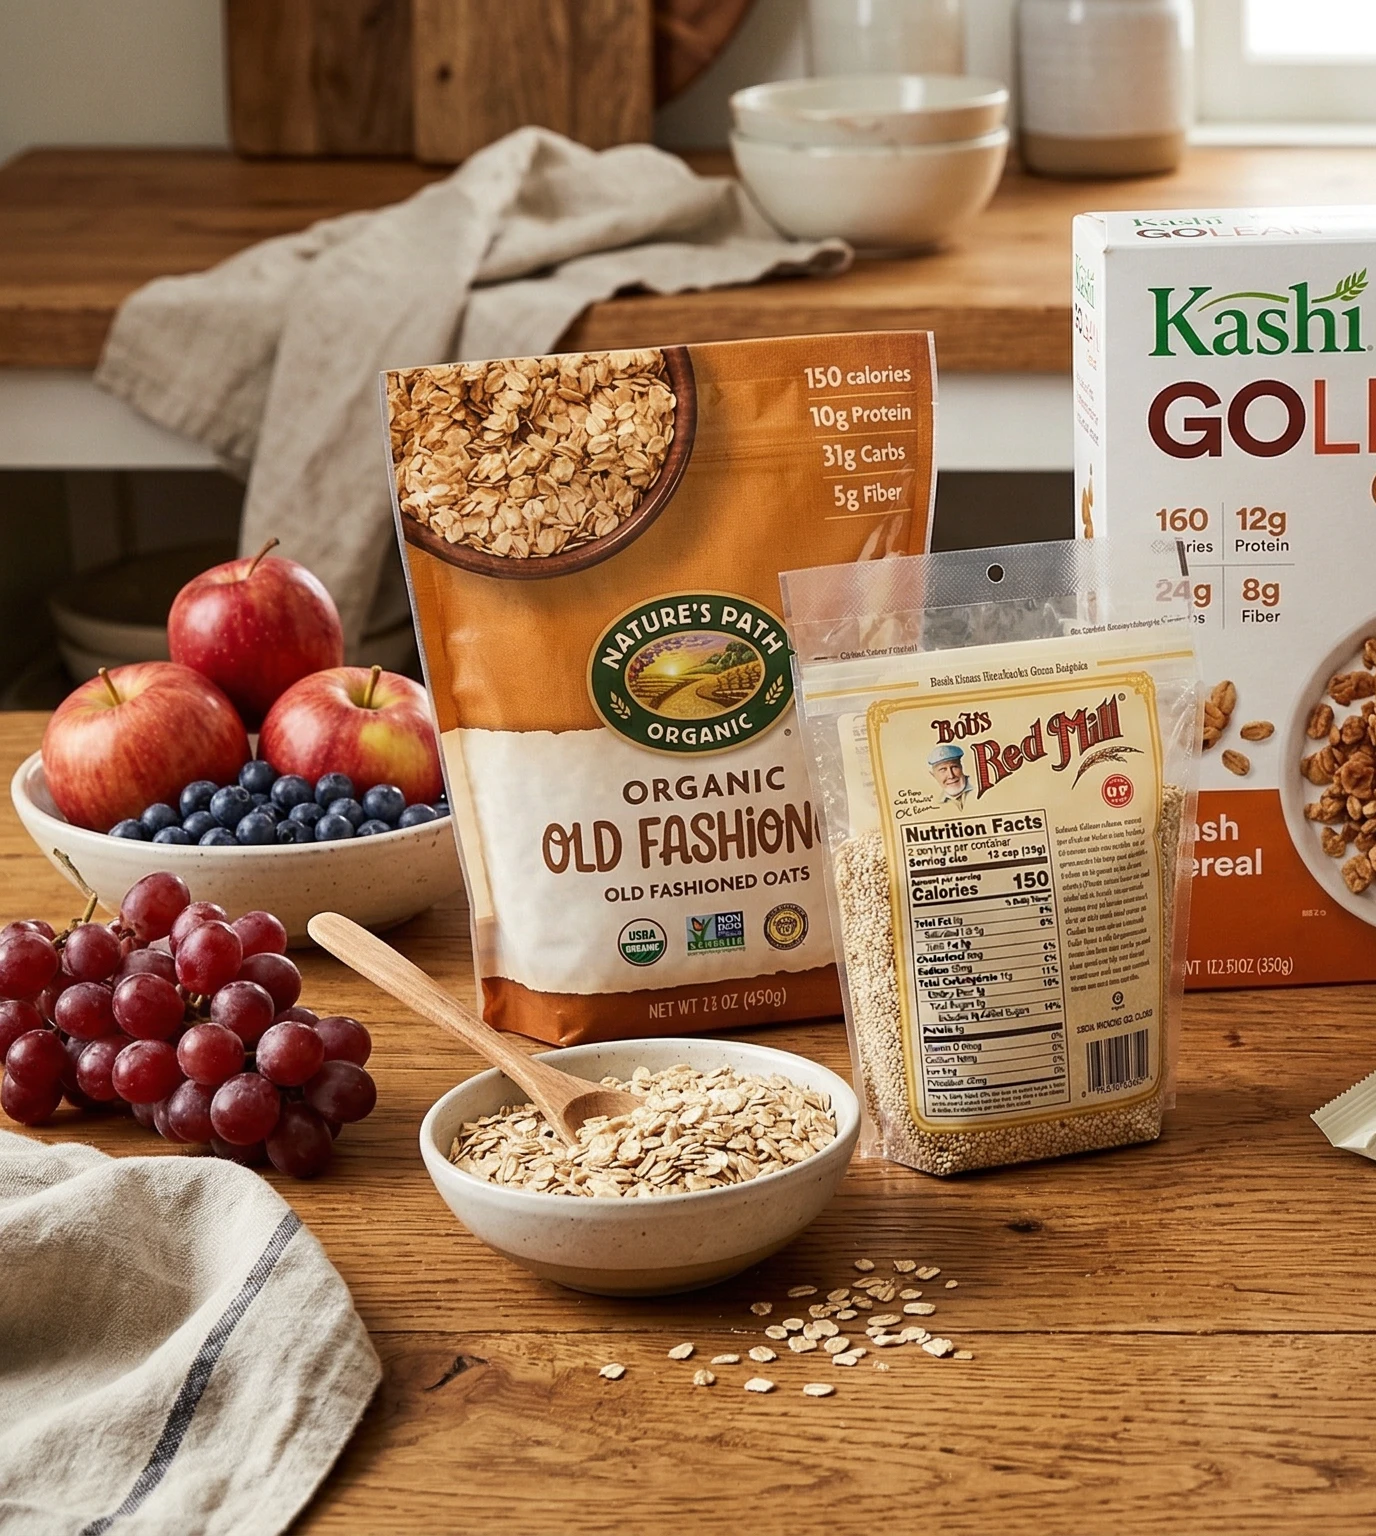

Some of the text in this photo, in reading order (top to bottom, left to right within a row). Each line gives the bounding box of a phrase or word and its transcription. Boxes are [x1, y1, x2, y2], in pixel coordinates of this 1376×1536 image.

[1148, 281, 1367, 357] Kashi
[804, 365, 912, 390] 150 calories
[809, 403, 912, 432] 10g Protein
[822, 443, 906, 470] 31g Carbs
[832, 483, 903, 511] 5g Fiber
[1156, 507, 1287, 537] 160 12g
[1183, 538, 1290, 553] ries Protein
[1155, 578, 1281, 608] 24g 8g
[1242, 609, 1281, 623] Fiber
[602, 603, 784, 670] NATURE'S PATH
[647, 712, 753, 745] ORGANIC
[970, 692, 1124, 799] Red Mill
[622, 766, 786, 805] ORGANIC
[542, 800, 822, 875] OLD FASHION
[905, 815, 1043, 843] Nutrition Facts
[604, 865, 811, 903] OLD FASHIONED OATS
[912, 870, 1050, 902] Calories 150
[649, 1002, 675, 1019] NET
[678, 998, 698, 1014] WT
[721, 993, 739, 1010] OZ
